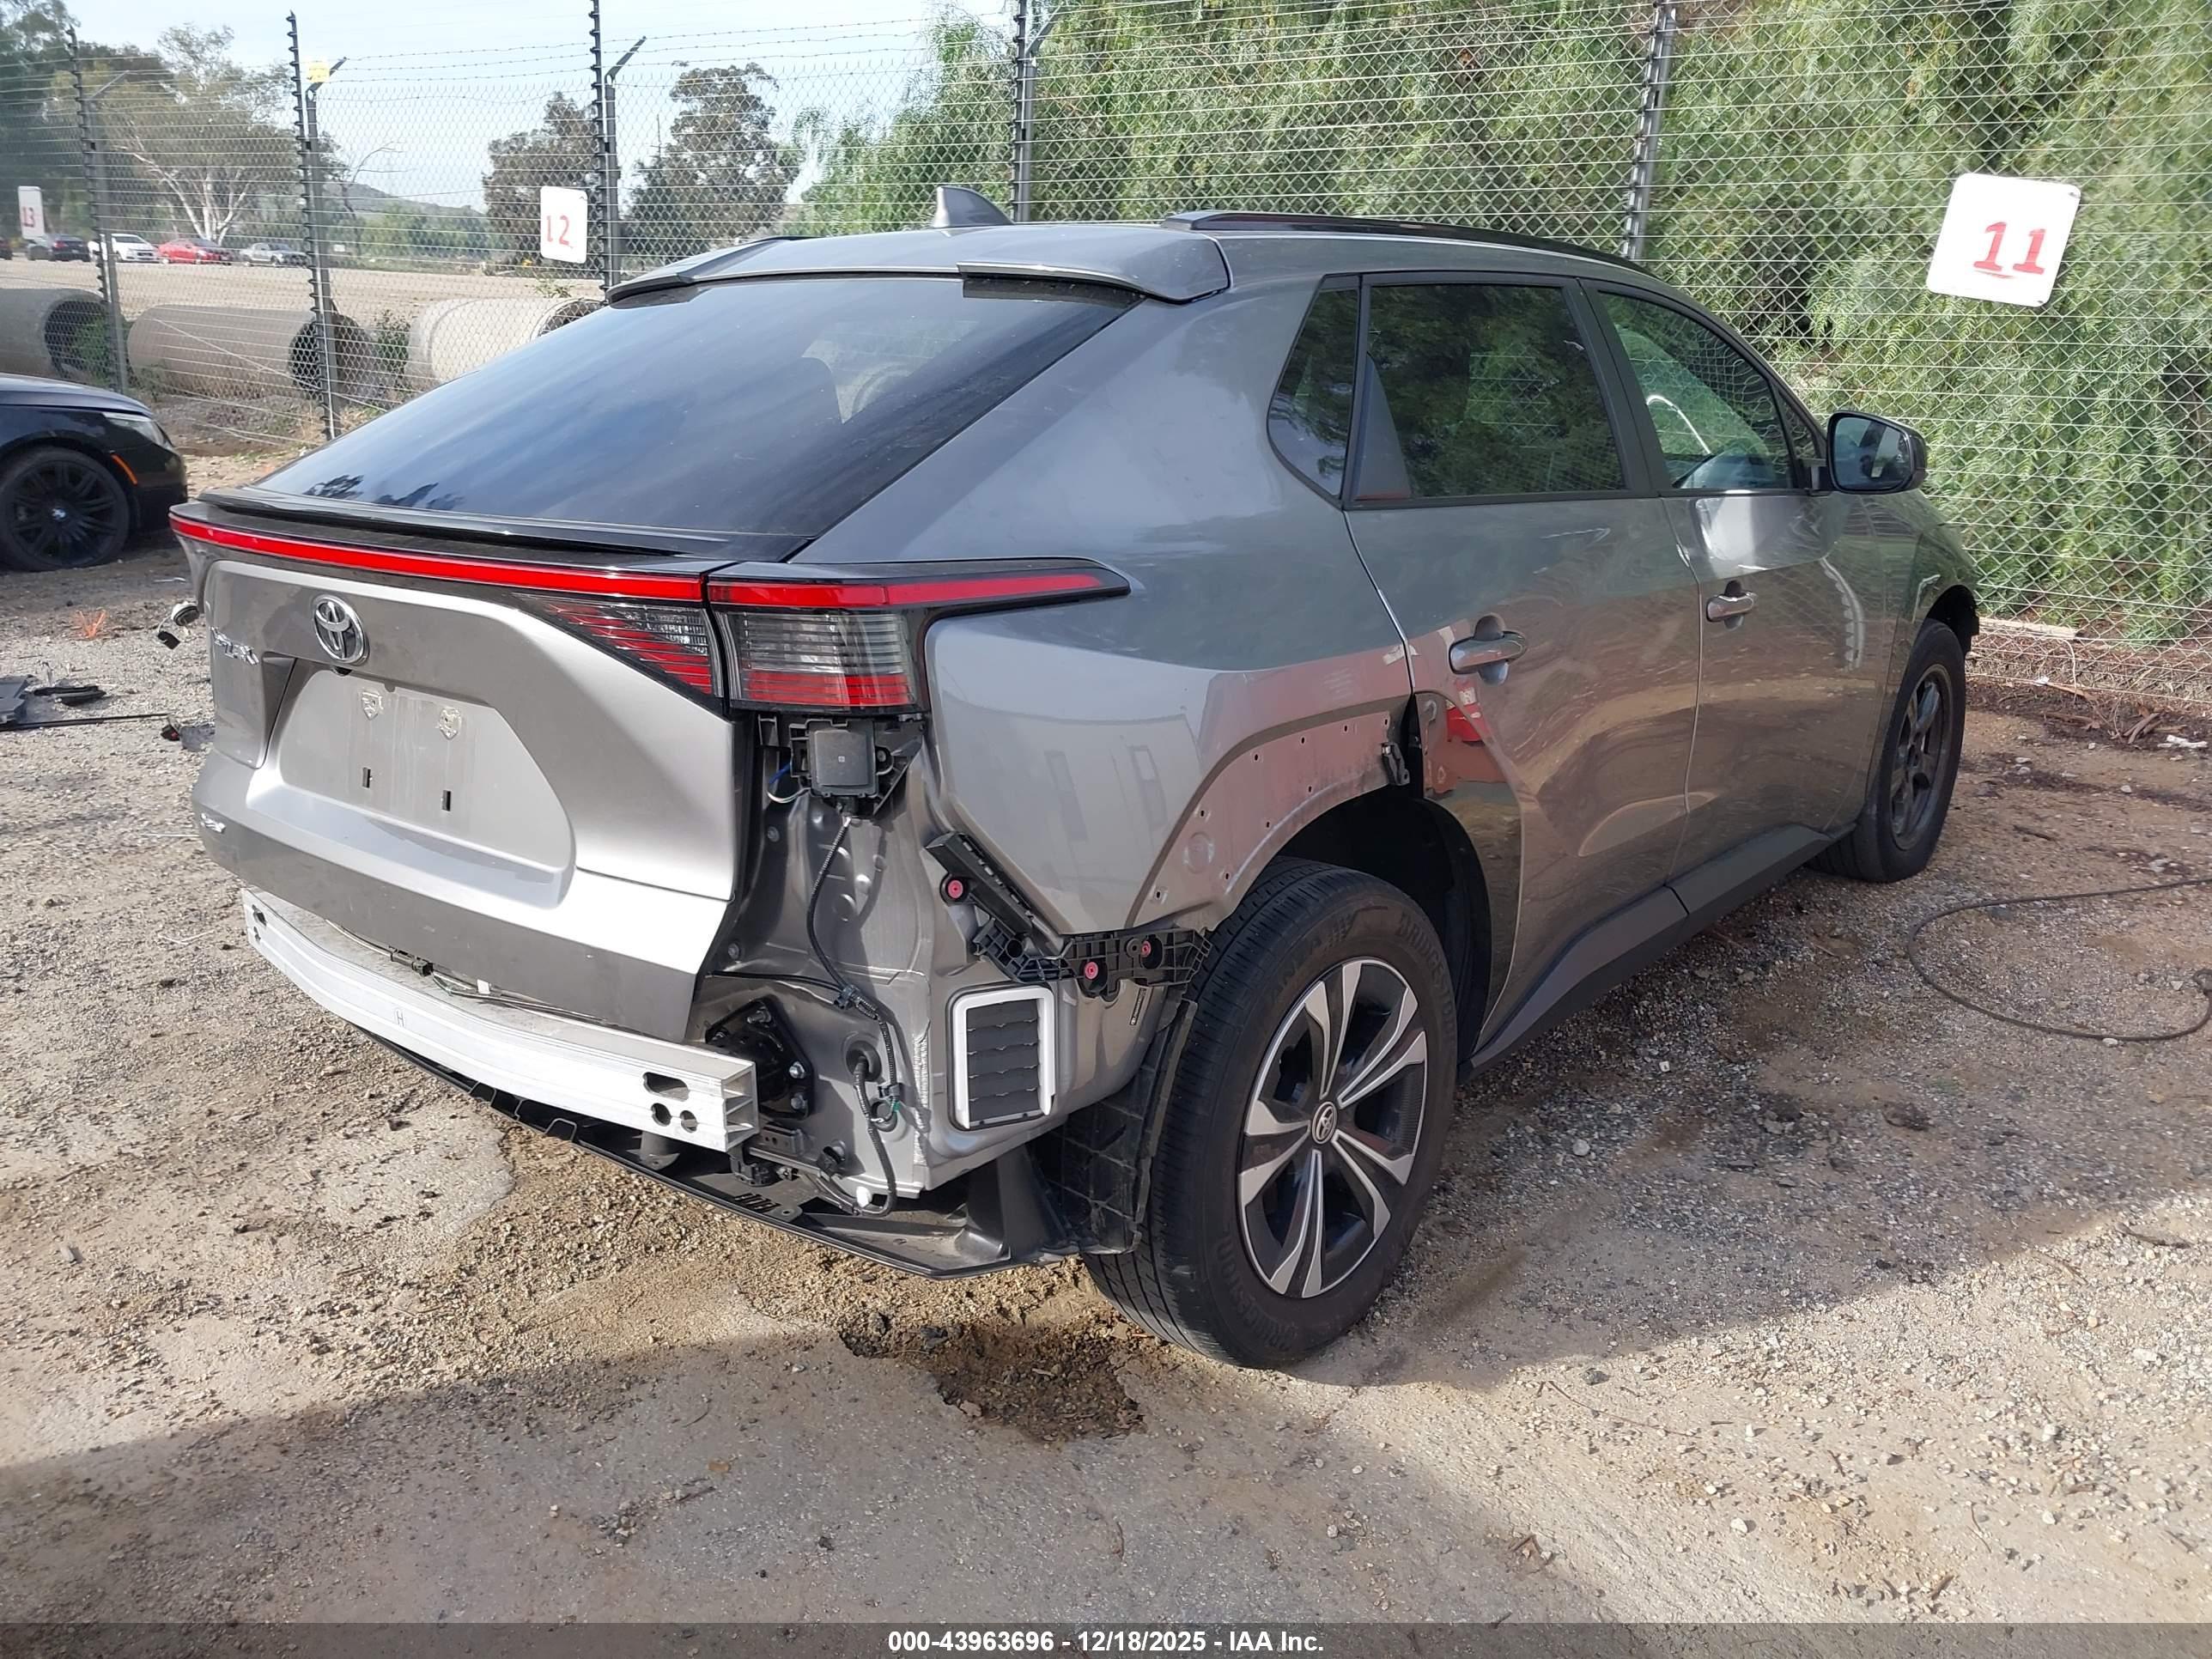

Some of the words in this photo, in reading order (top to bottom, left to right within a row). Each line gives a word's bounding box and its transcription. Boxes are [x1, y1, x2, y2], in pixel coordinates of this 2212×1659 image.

[22, 207, 35, 228] 13
[546, 215, 569, 246] 12
[1973, 222, 2047, 275] 11
